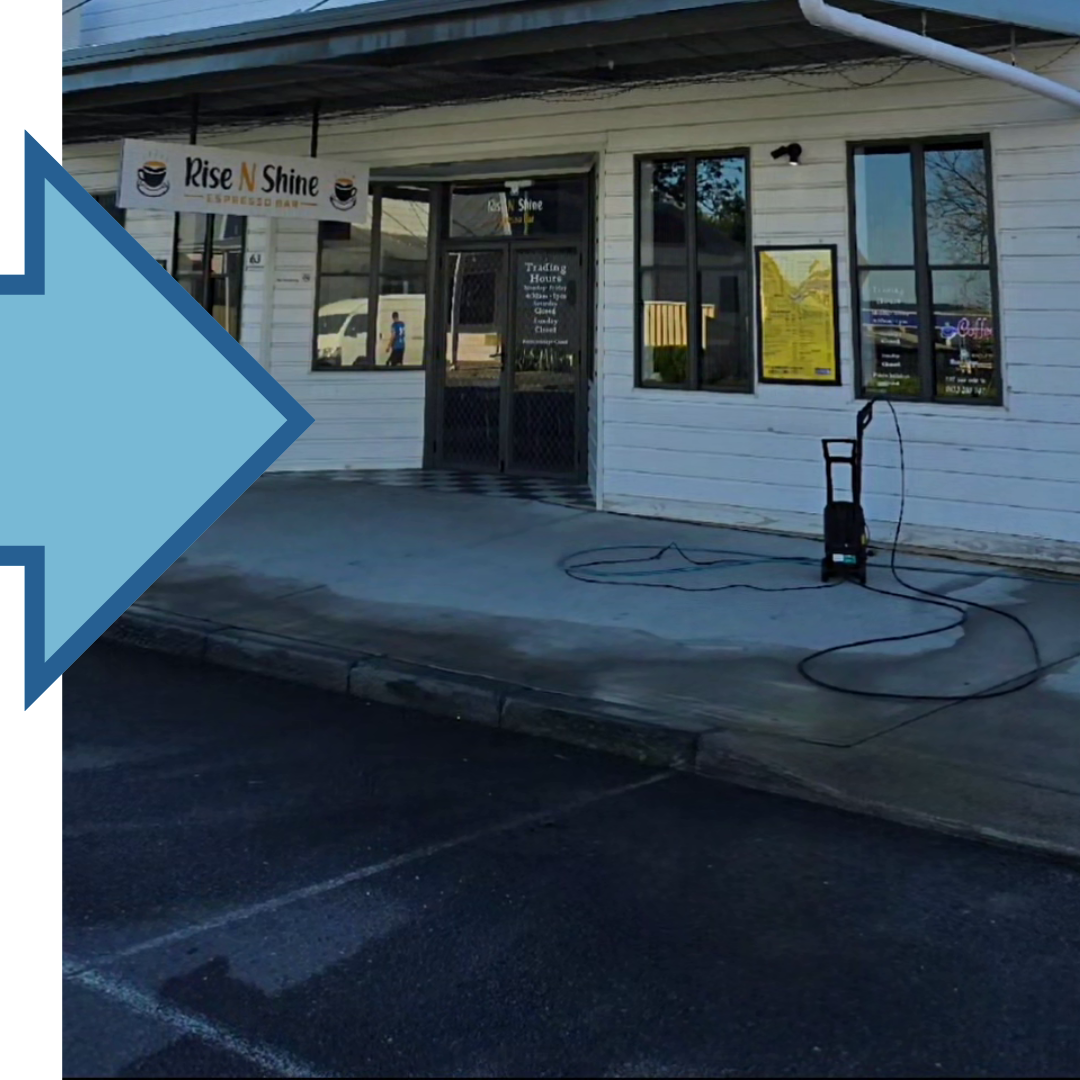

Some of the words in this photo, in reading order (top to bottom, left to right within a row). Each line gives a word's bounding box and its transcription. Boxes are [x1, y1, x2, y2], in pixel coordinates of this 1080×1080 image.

[184, 156, 233, 190] Rise
[238, 161, 257, 192] N
[261, 164, 319, 197] Shine
[207, 193, 271, 207] ESPRESSO
[524, 262, 567, 276] Trading
[529, 273, 562, 283] Hours
